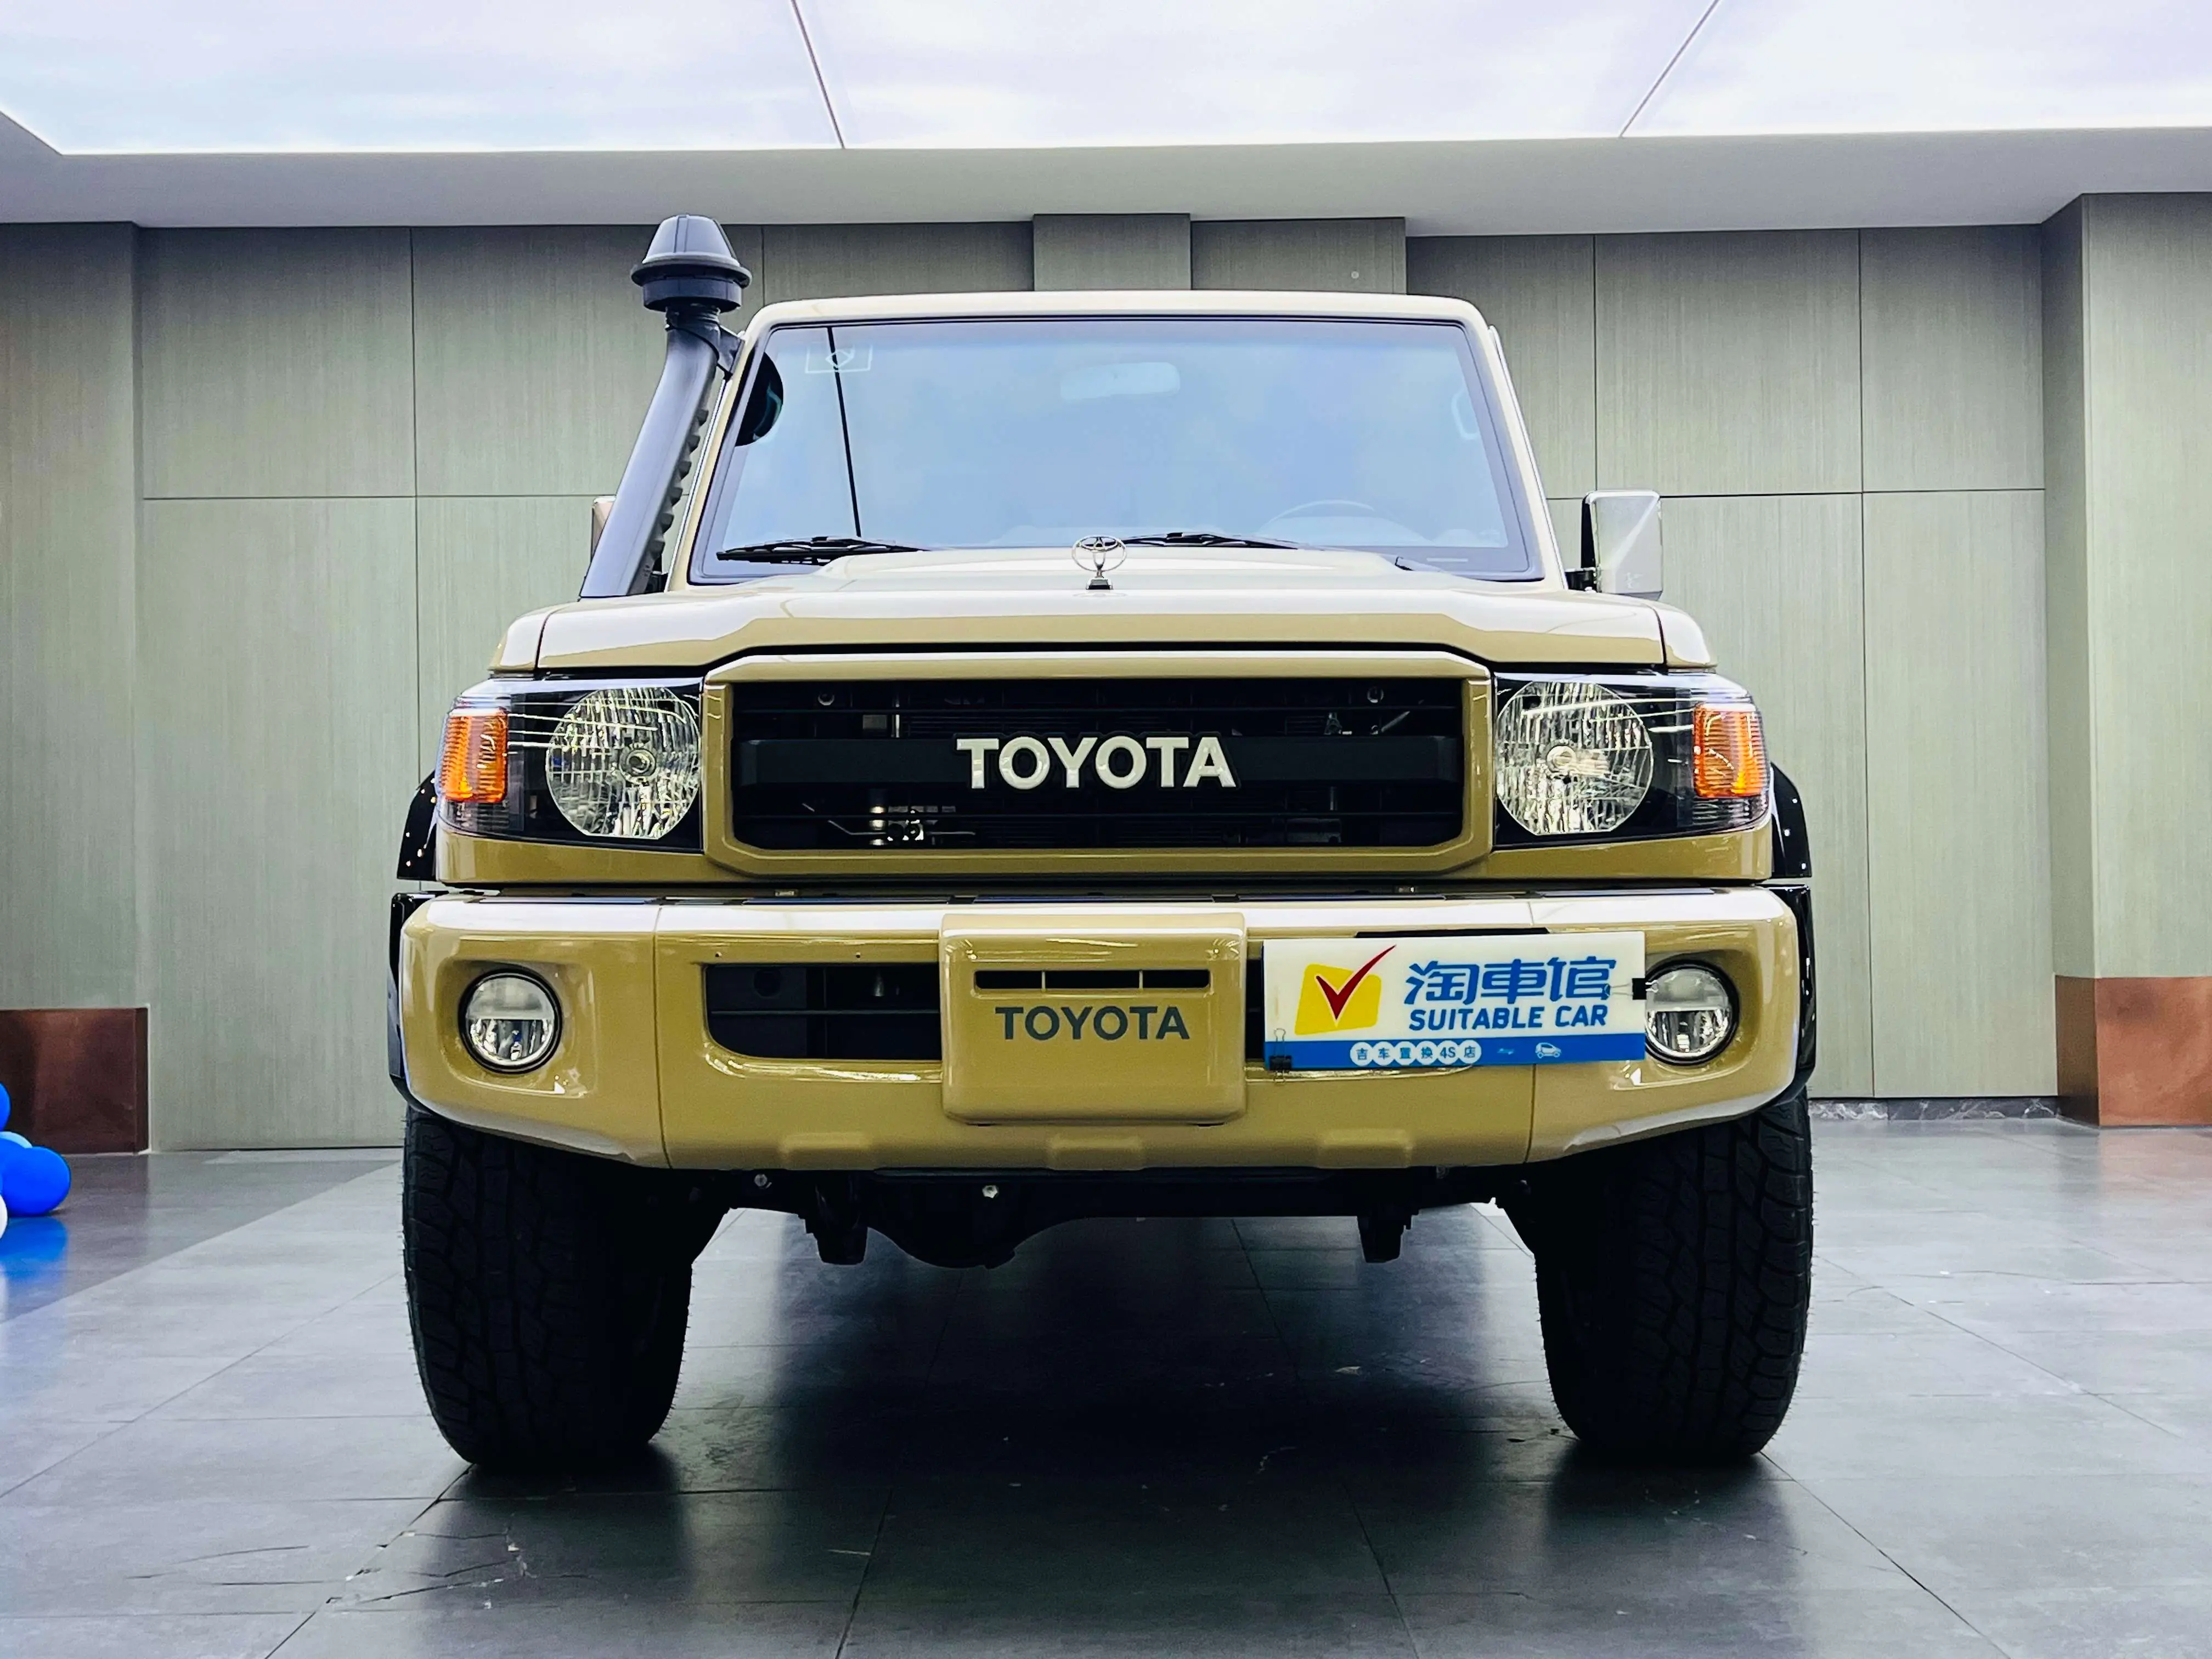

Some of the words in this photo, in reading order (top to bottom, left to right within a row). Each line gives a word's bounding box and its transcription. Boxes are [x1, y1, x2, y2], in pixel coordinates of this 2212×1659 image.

[956, 736, 1236, 789] TOYOTA
[995, 1006, 1190, 1041] TOYOTA
[1409, 1006, 1545, 1031] SUITABLE
[1555, 1003, 1609, 1028] CAR
